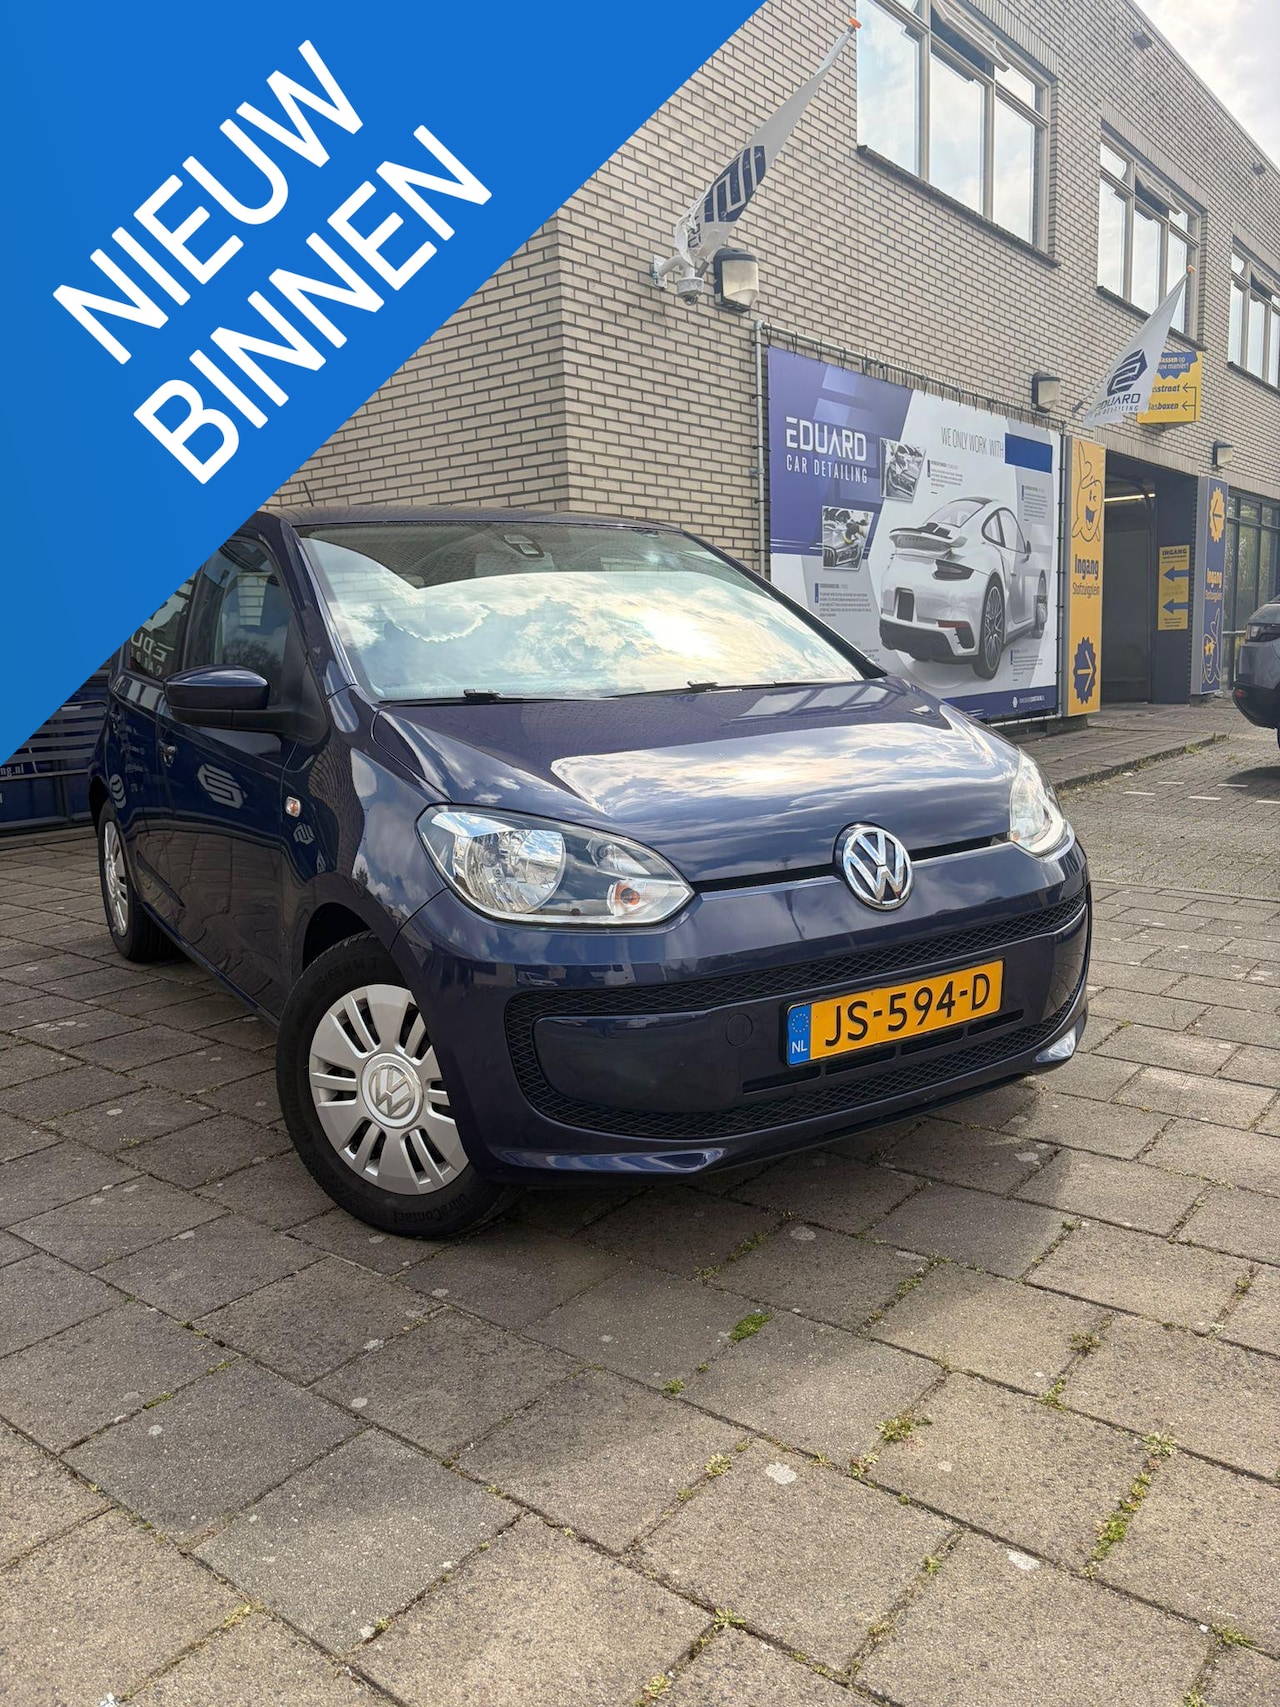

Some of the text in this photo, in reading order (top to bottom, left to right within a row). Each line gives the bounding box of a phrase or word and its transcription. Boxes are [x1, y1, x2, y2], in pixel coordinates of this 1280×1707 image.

[1152, 384, 1180, 393] sstraat
[786, 416, 867, 462] EDUARD
[941, 426, 1004, 460] WE ONLY WORK WITH
[786, 454, 868, 484] CAR DETAILING
[1162, 548, 1187, 556] INGANG
[1074, 553, 1099, 580] Ingang
[0, 763, 25, 778] ng.nl
[845, 828, 911, 907] VW
[825, 973, 991, 1047] JS-594-D
[791, 1039, 808, 1054] NL
